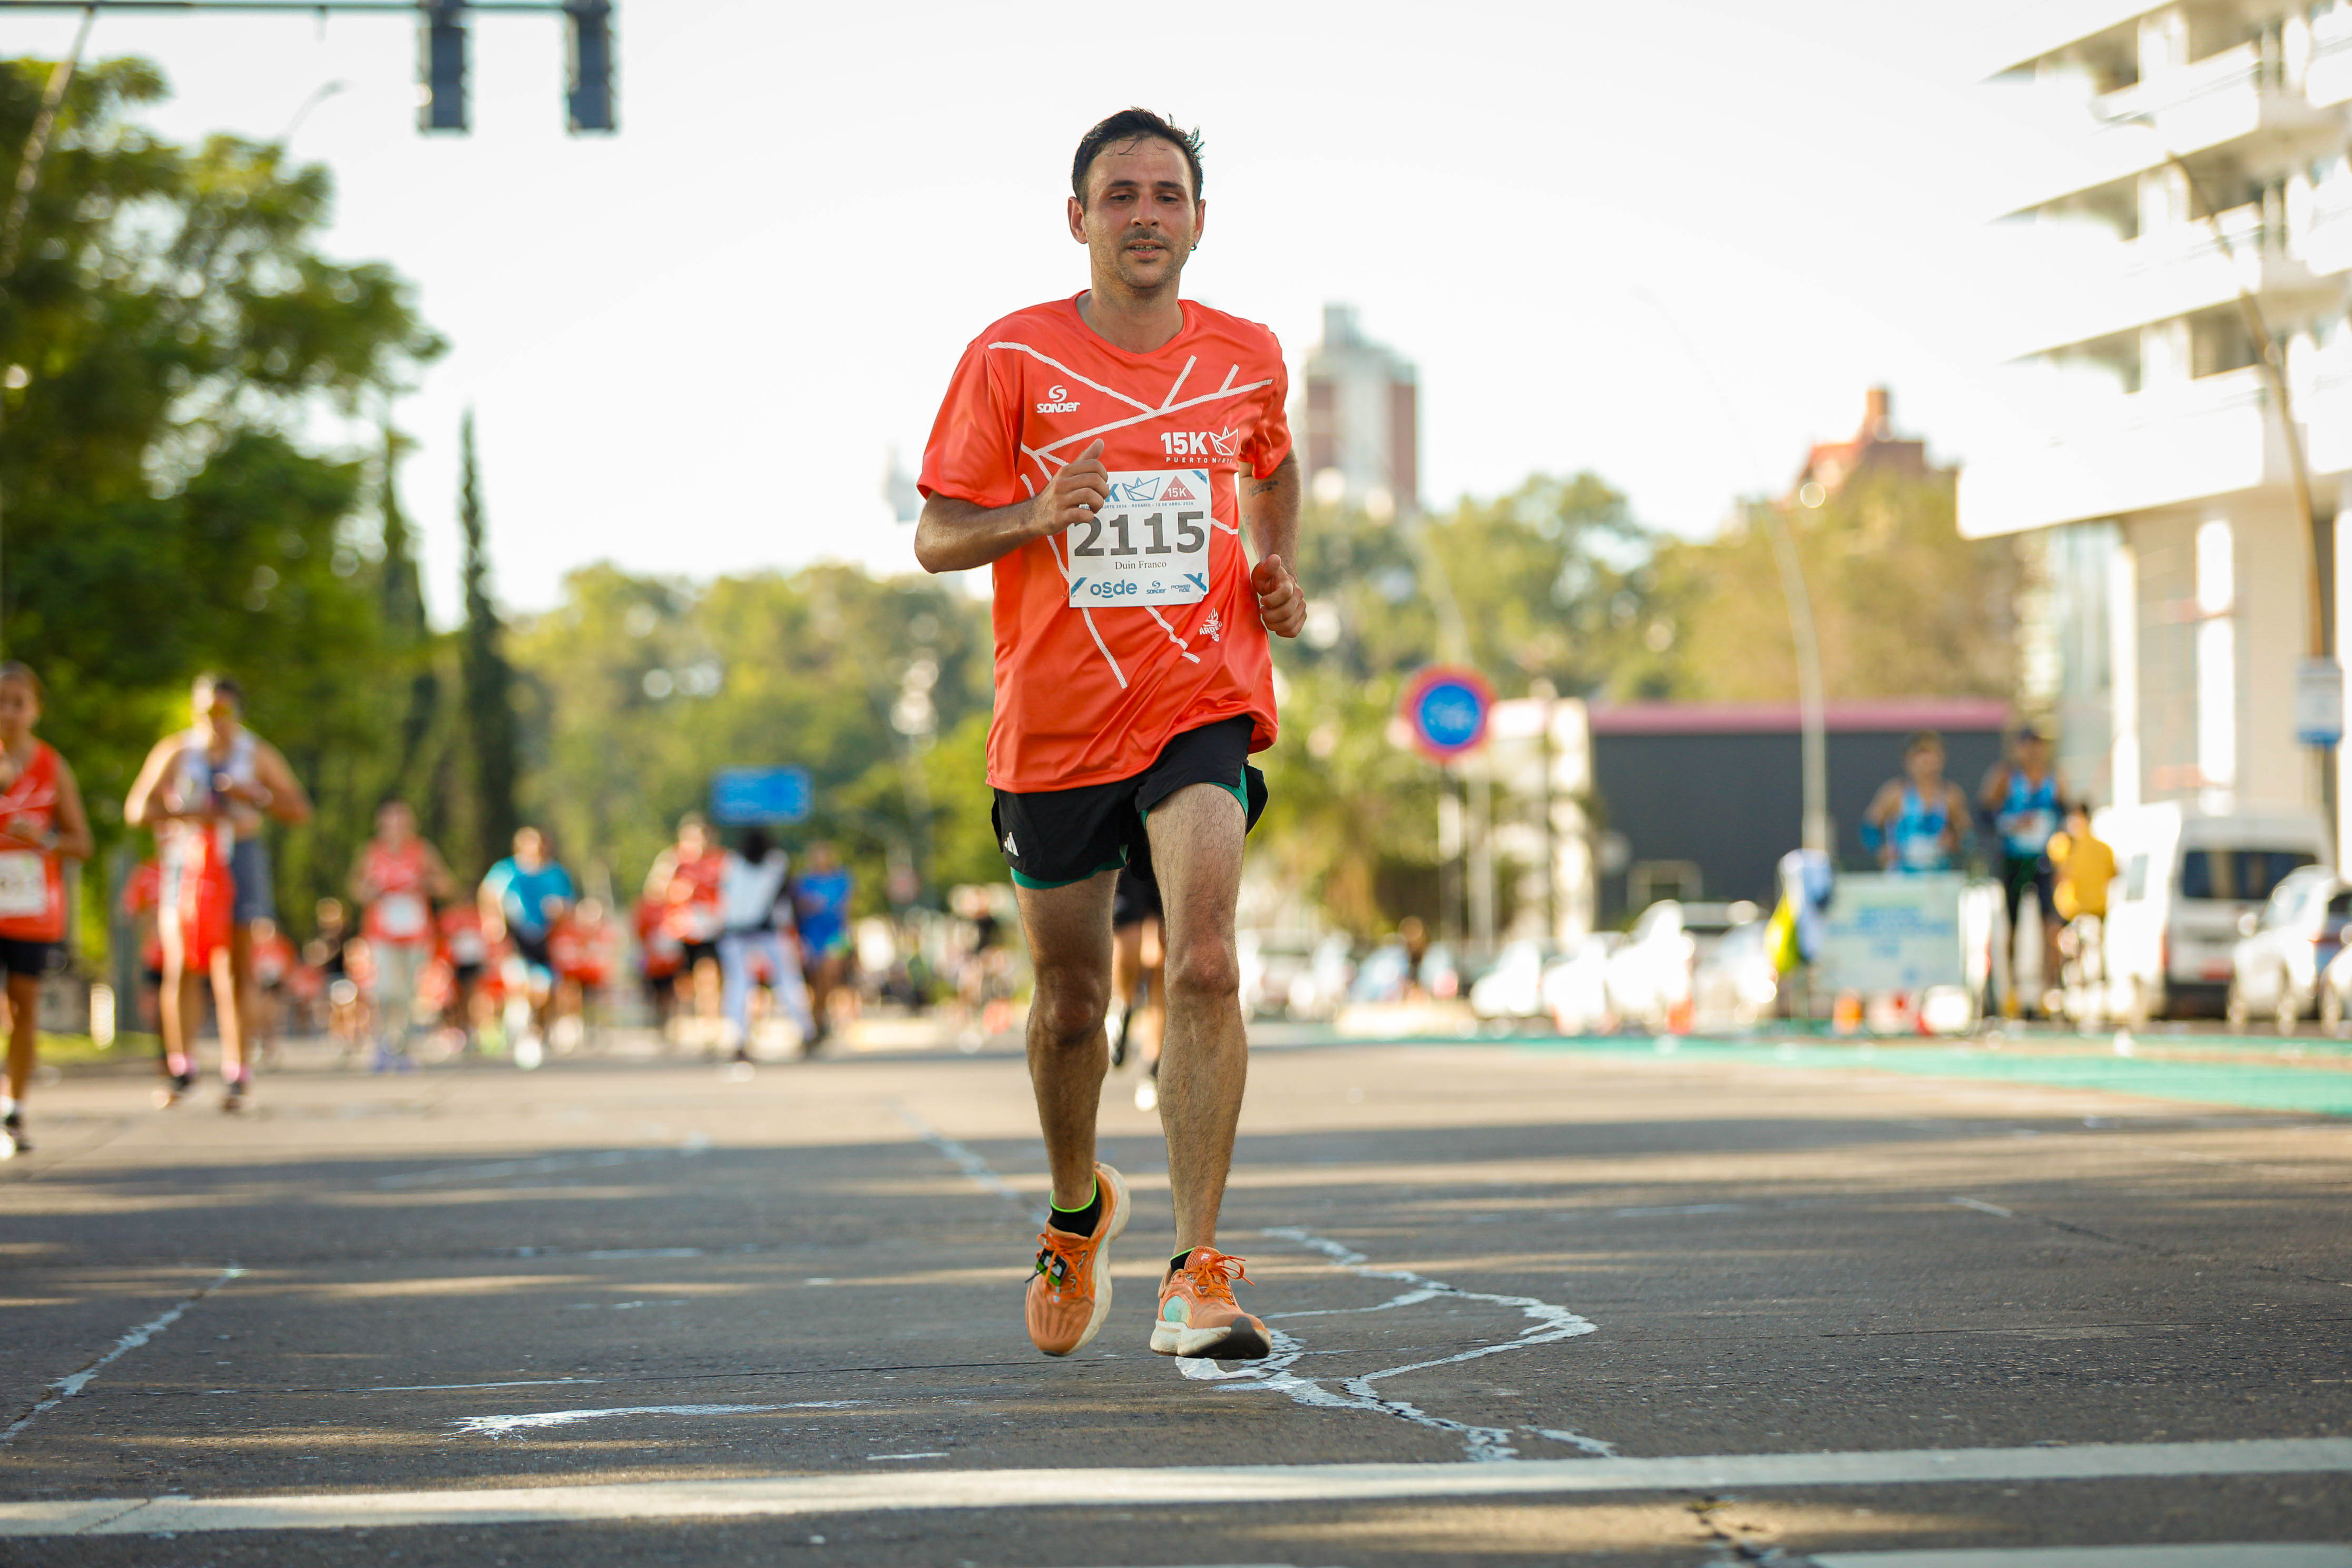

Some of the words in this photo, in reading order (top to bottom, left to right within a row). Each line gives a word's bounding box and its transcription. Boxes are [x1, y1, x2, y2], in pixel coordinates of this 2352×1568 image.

[1161, 432, 1209, 455] 15K
[1168, 487, 1187, 498] 15K
[1074, 511, 1205, 556] 2115
[1115, 561, 1136, 570] Duin
[1139, 561, 1167, 569] Franco
[1090, 580, 1138, 596] osde
